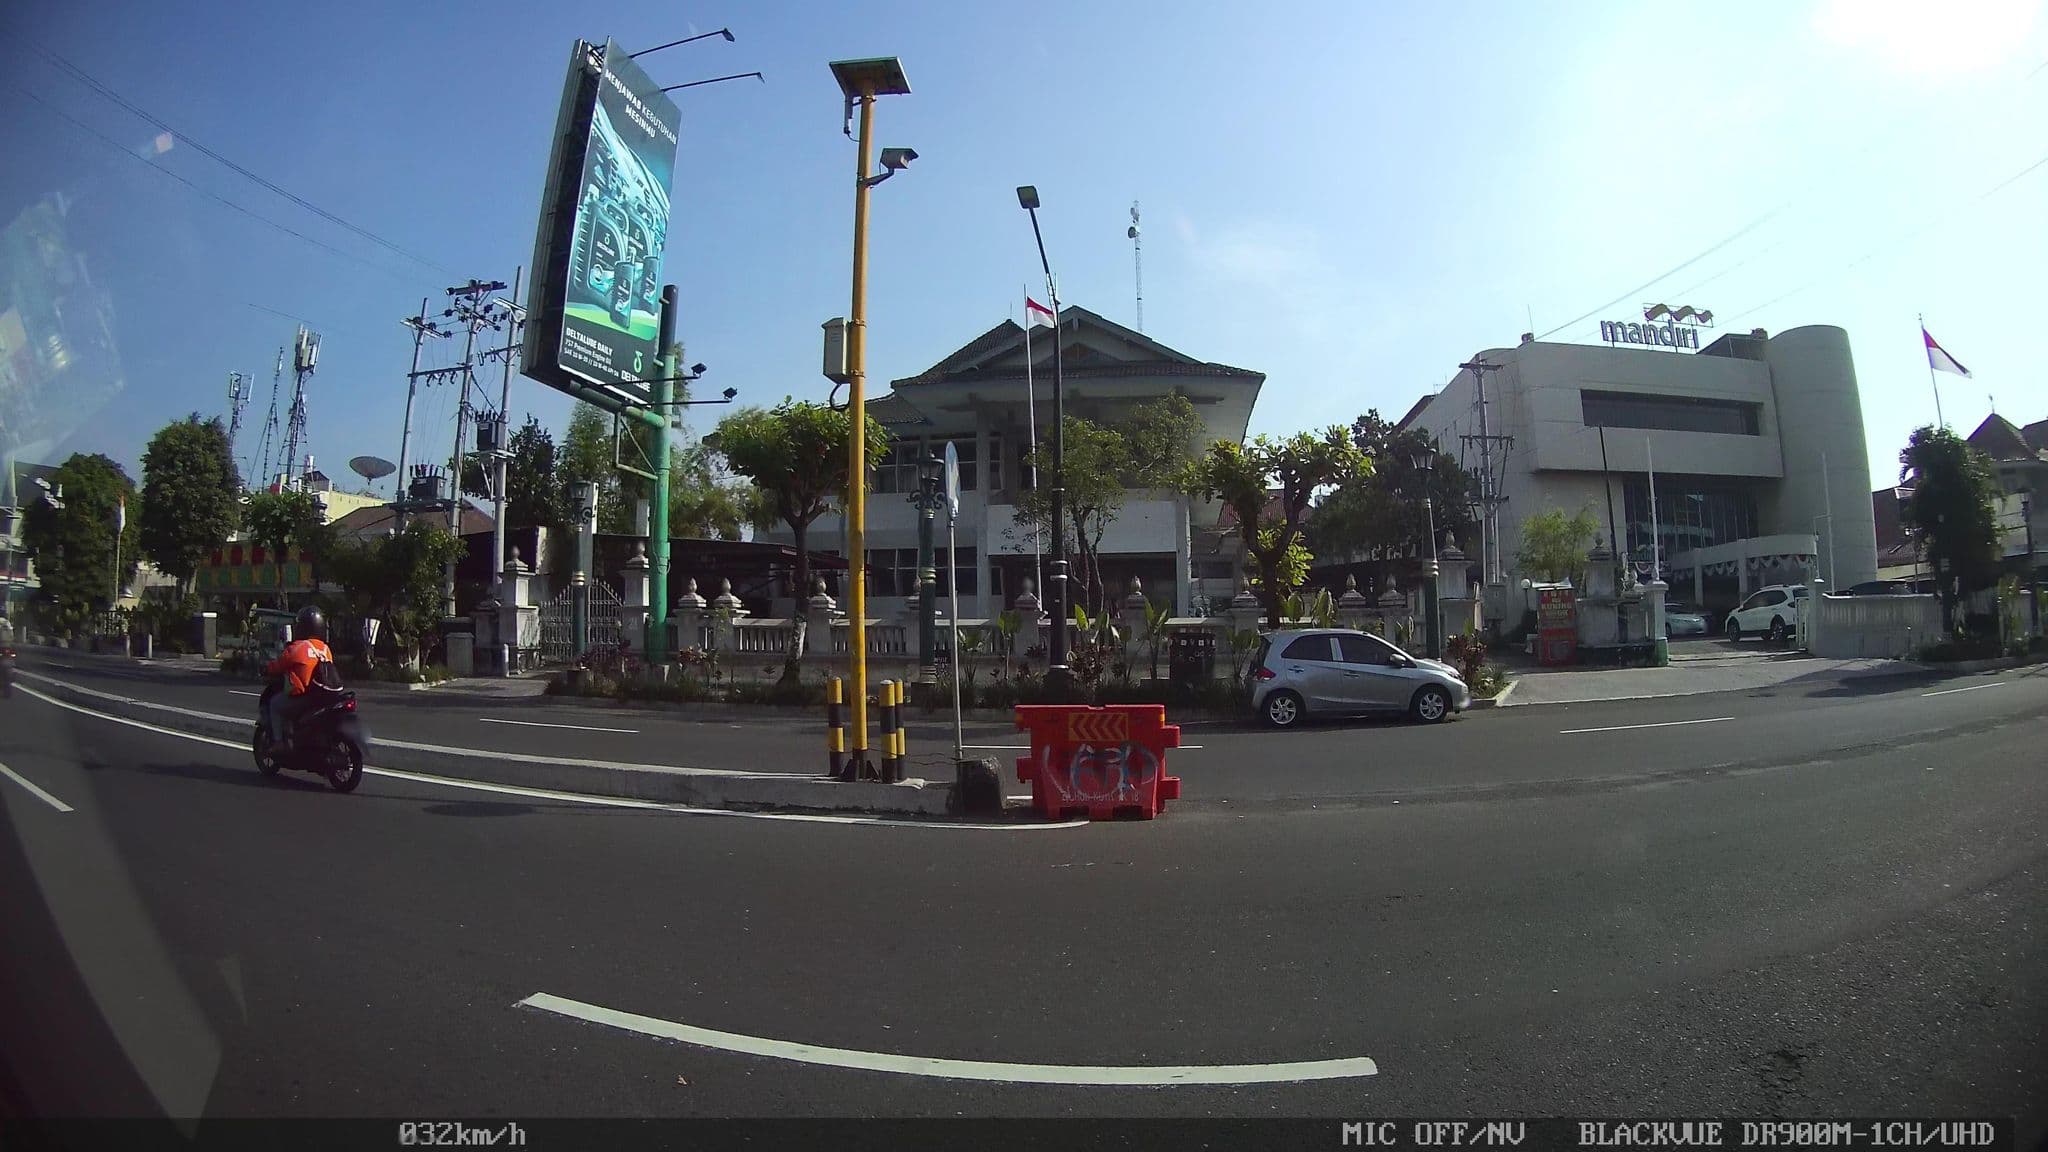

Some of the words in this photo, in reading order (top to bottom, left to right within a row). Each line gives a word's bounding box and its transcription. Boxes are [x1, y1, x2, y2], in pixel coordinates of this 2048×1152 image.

[605, 69, 642, 110] MENJAWAB
[642, 105, 677, 144] KEBUTUHAN
[625, 104, 656, 138] MESINMU
[566, 328, 596, 349] DELTALUBE
[597, 342, 613, 356] DAILY
[1600, 320, 1699, 348] mandiri
